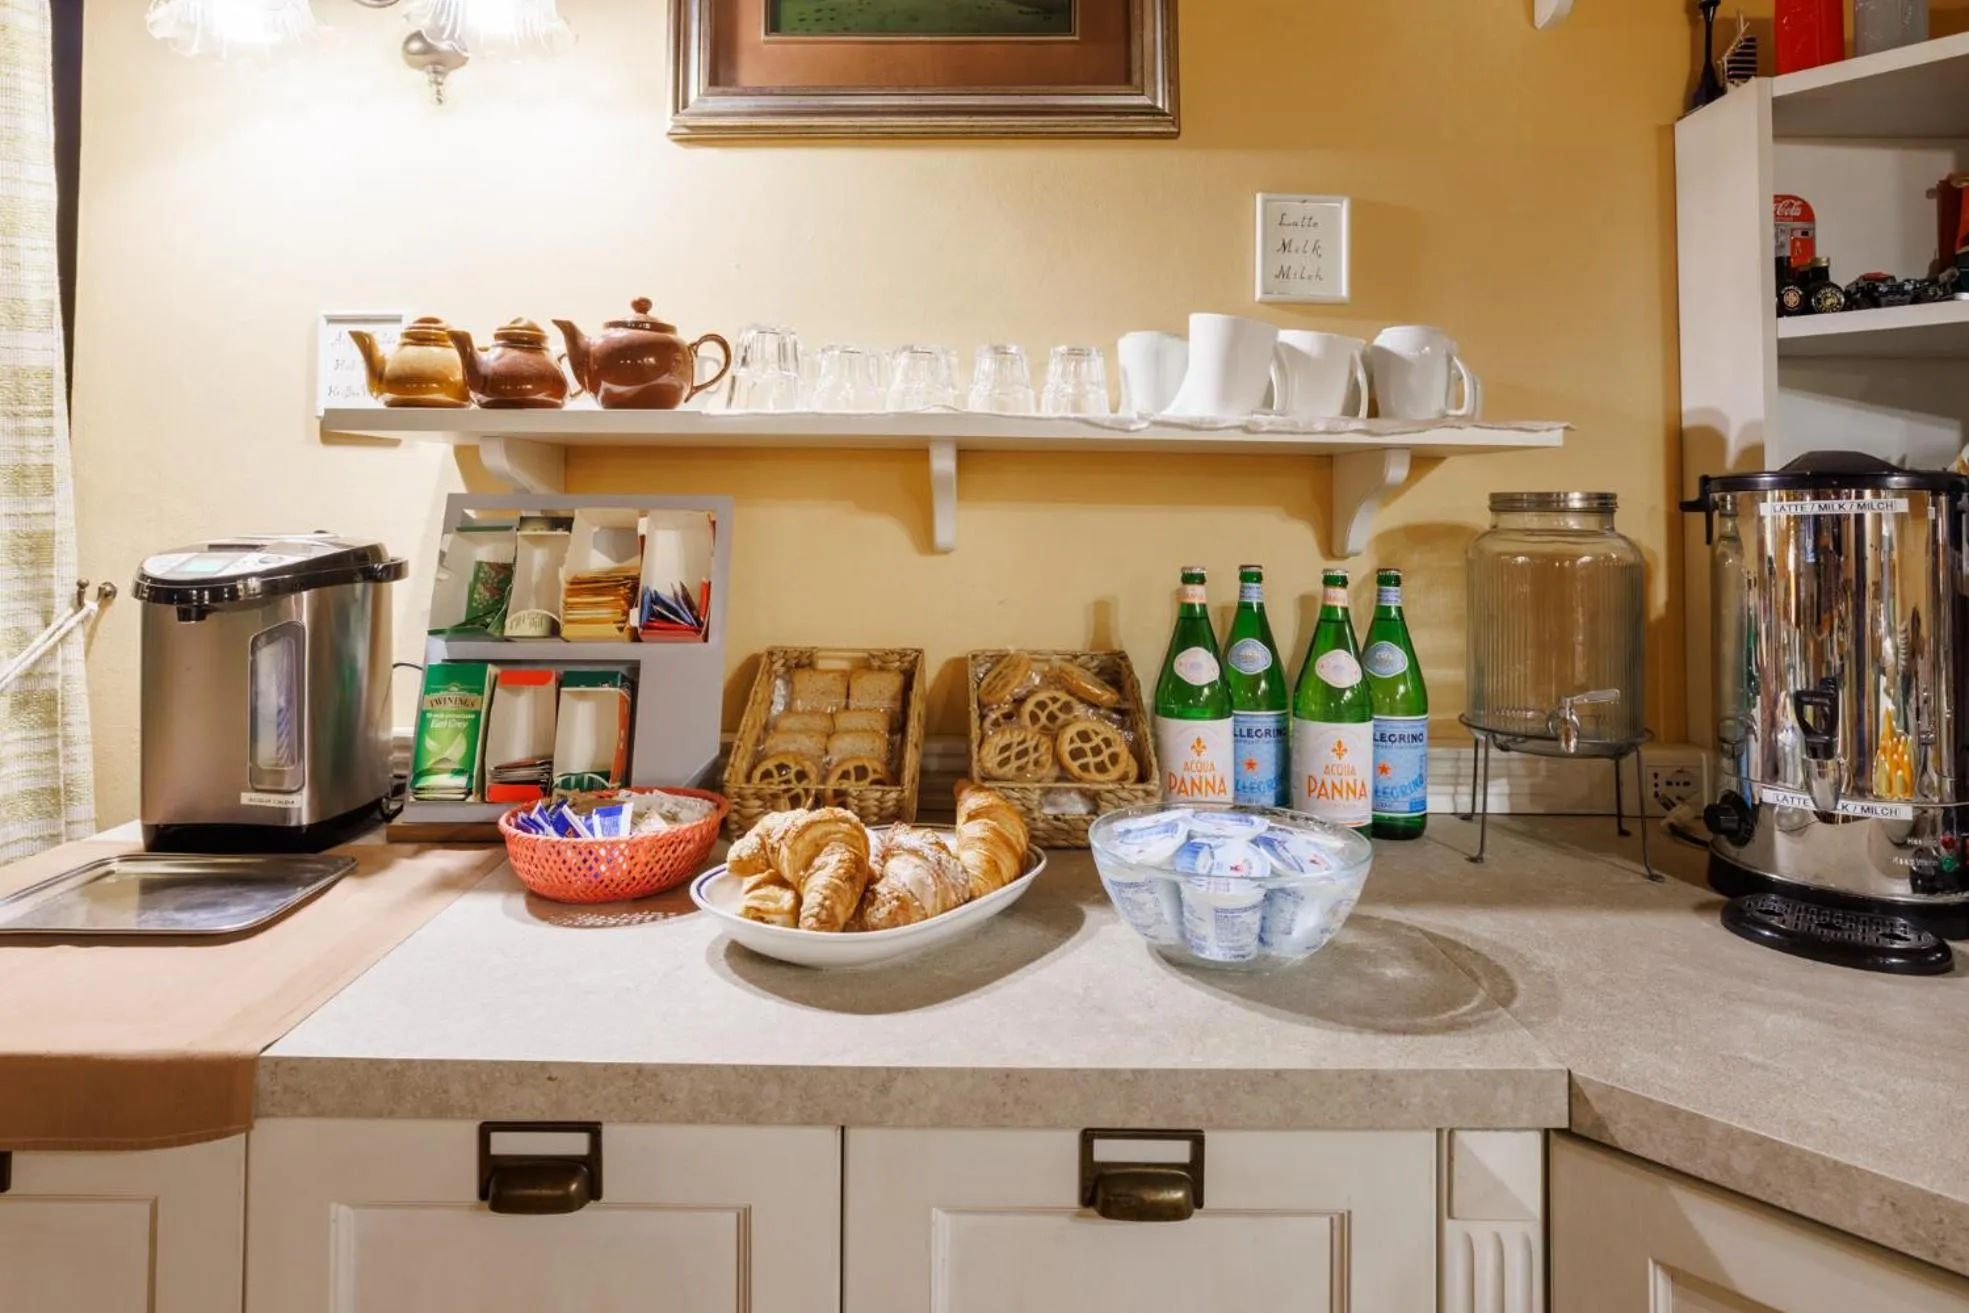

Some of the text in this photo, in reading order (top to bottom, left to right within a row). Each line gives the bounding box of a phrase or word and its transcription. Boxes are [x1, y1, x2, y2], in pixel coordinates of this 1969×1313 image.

[1278, 212, 1319, 228] Latte
[1276, 238, 1322, 258] Milk
[1274, 264, 1324, 281] Milch
[1773, 503, 1806, 513] LATTE
[1818, 502, 1847, 512] MILK
[1857, 501, 1894, 511] MILCH
[428, 695, 478, 708] TWININGS
[1183, 760, 1215, 772] ACQUA
[1323, 764, 1357, 776] ACQUA
[1167, 772, 1228, 798] PANNA
[1307, 775, 1368, 801] PANNA
[1775, 795, 1811, 807] LATTE
[1860, 805, 1898, 817] MILCH
